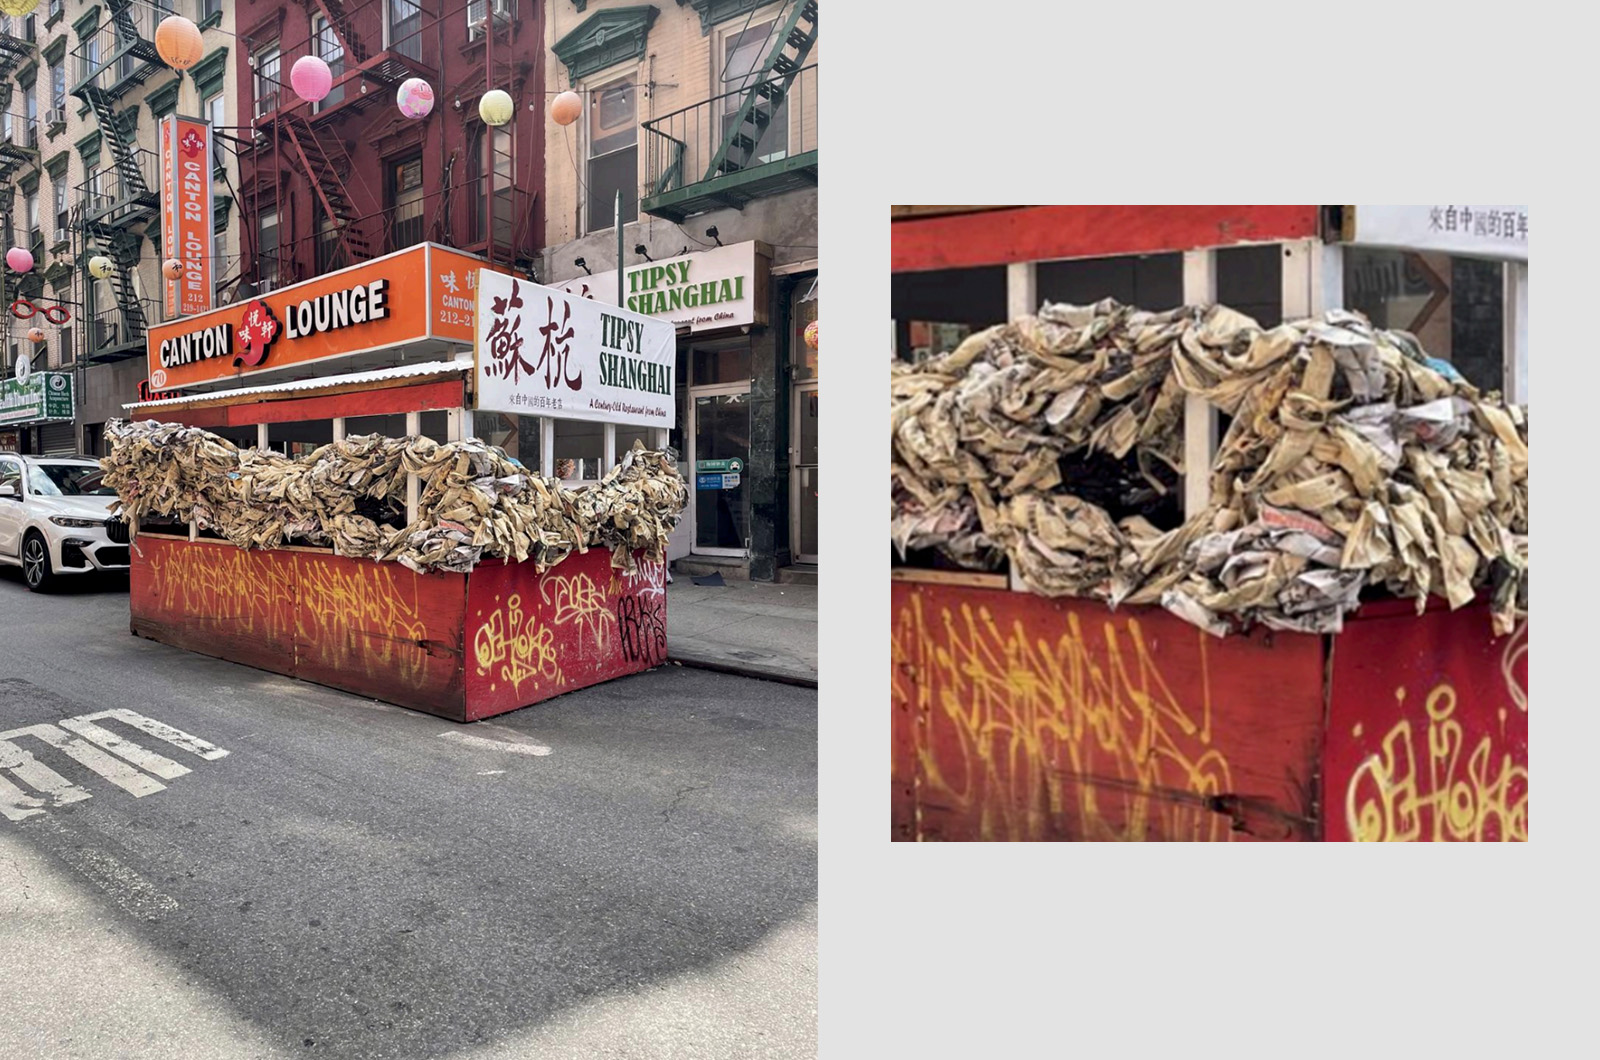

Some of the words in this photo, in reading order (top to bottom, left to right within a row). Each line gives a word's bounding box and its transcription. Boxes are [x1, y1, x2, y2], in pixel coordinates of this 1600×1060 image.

[184, 161, 202, 222] CANTON
[185, 231, 203, 290] LOUNGE
[627, 259, 692, 294] TIPSY
[187, 292, 204, 303] 212
[286, 280, 386, 338] LOUNGE
[442, 294, 475, 311] CANTON
[626, 275, 745, 316] SHANGHAI
[713, 311, 735, 321] China
[160, 325, 228, 368] CANTON
[600, 312, 644, 355] TIPSY
[153, 372, 165, 386] 70
[599, 351, 672, 396] SHANGHAI
